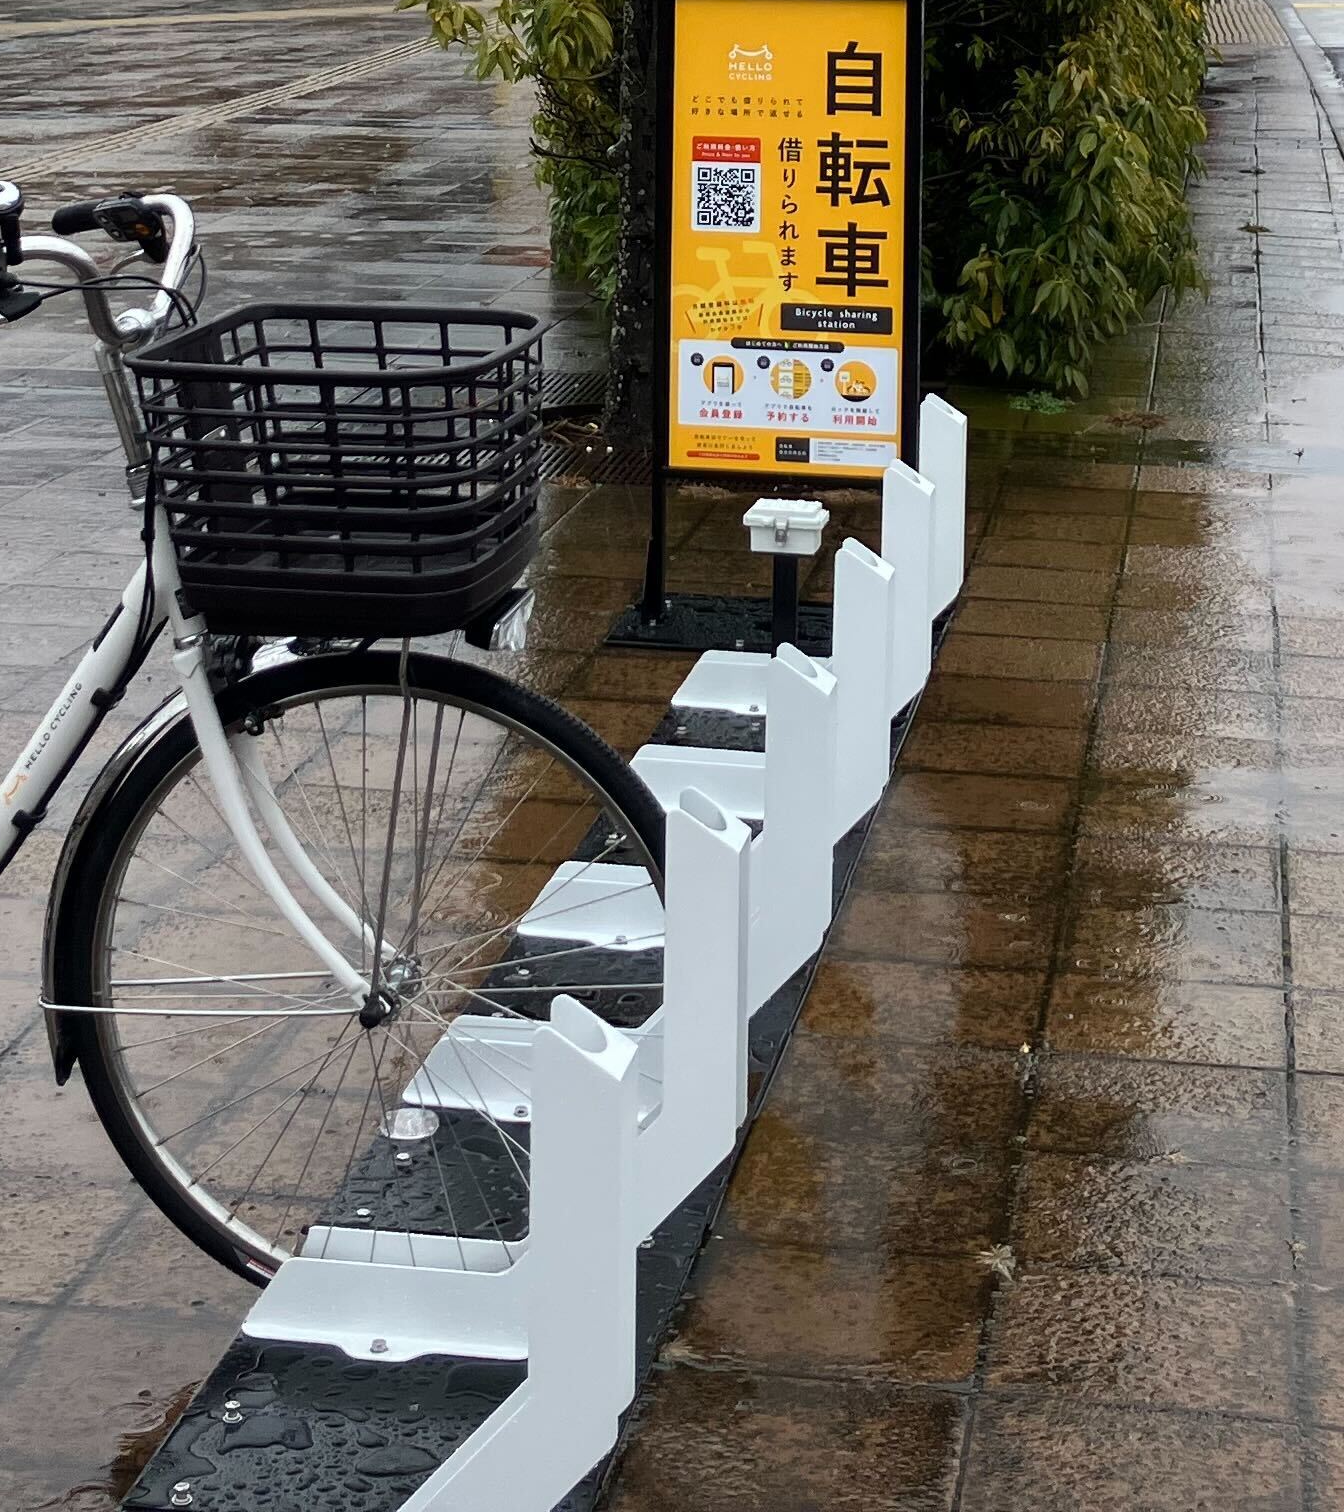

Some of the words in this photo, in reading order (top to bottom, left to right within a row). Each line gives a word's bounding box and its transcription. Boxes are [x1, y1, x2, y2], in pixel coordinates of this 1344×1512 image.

[727, 61, 774, 71] HELLO
[728, 73, 773, 81] CYCLING
[815, 40, 892, 298] 自転車
[777, 136, 804, 292] 借りられます
[795, 307, 834, 319] Bicycle
[839, 309, 879, 322] sharing
[817, 320, 857, 330] station
[698, 406, 744, 420] 会員登録
[766, 410, 811, 424] 予約する
[832, 414, 879, 427] 利用開始
[24, 732, 51, 769] HELLO
[50, 682, 83, 730] CYCLING
